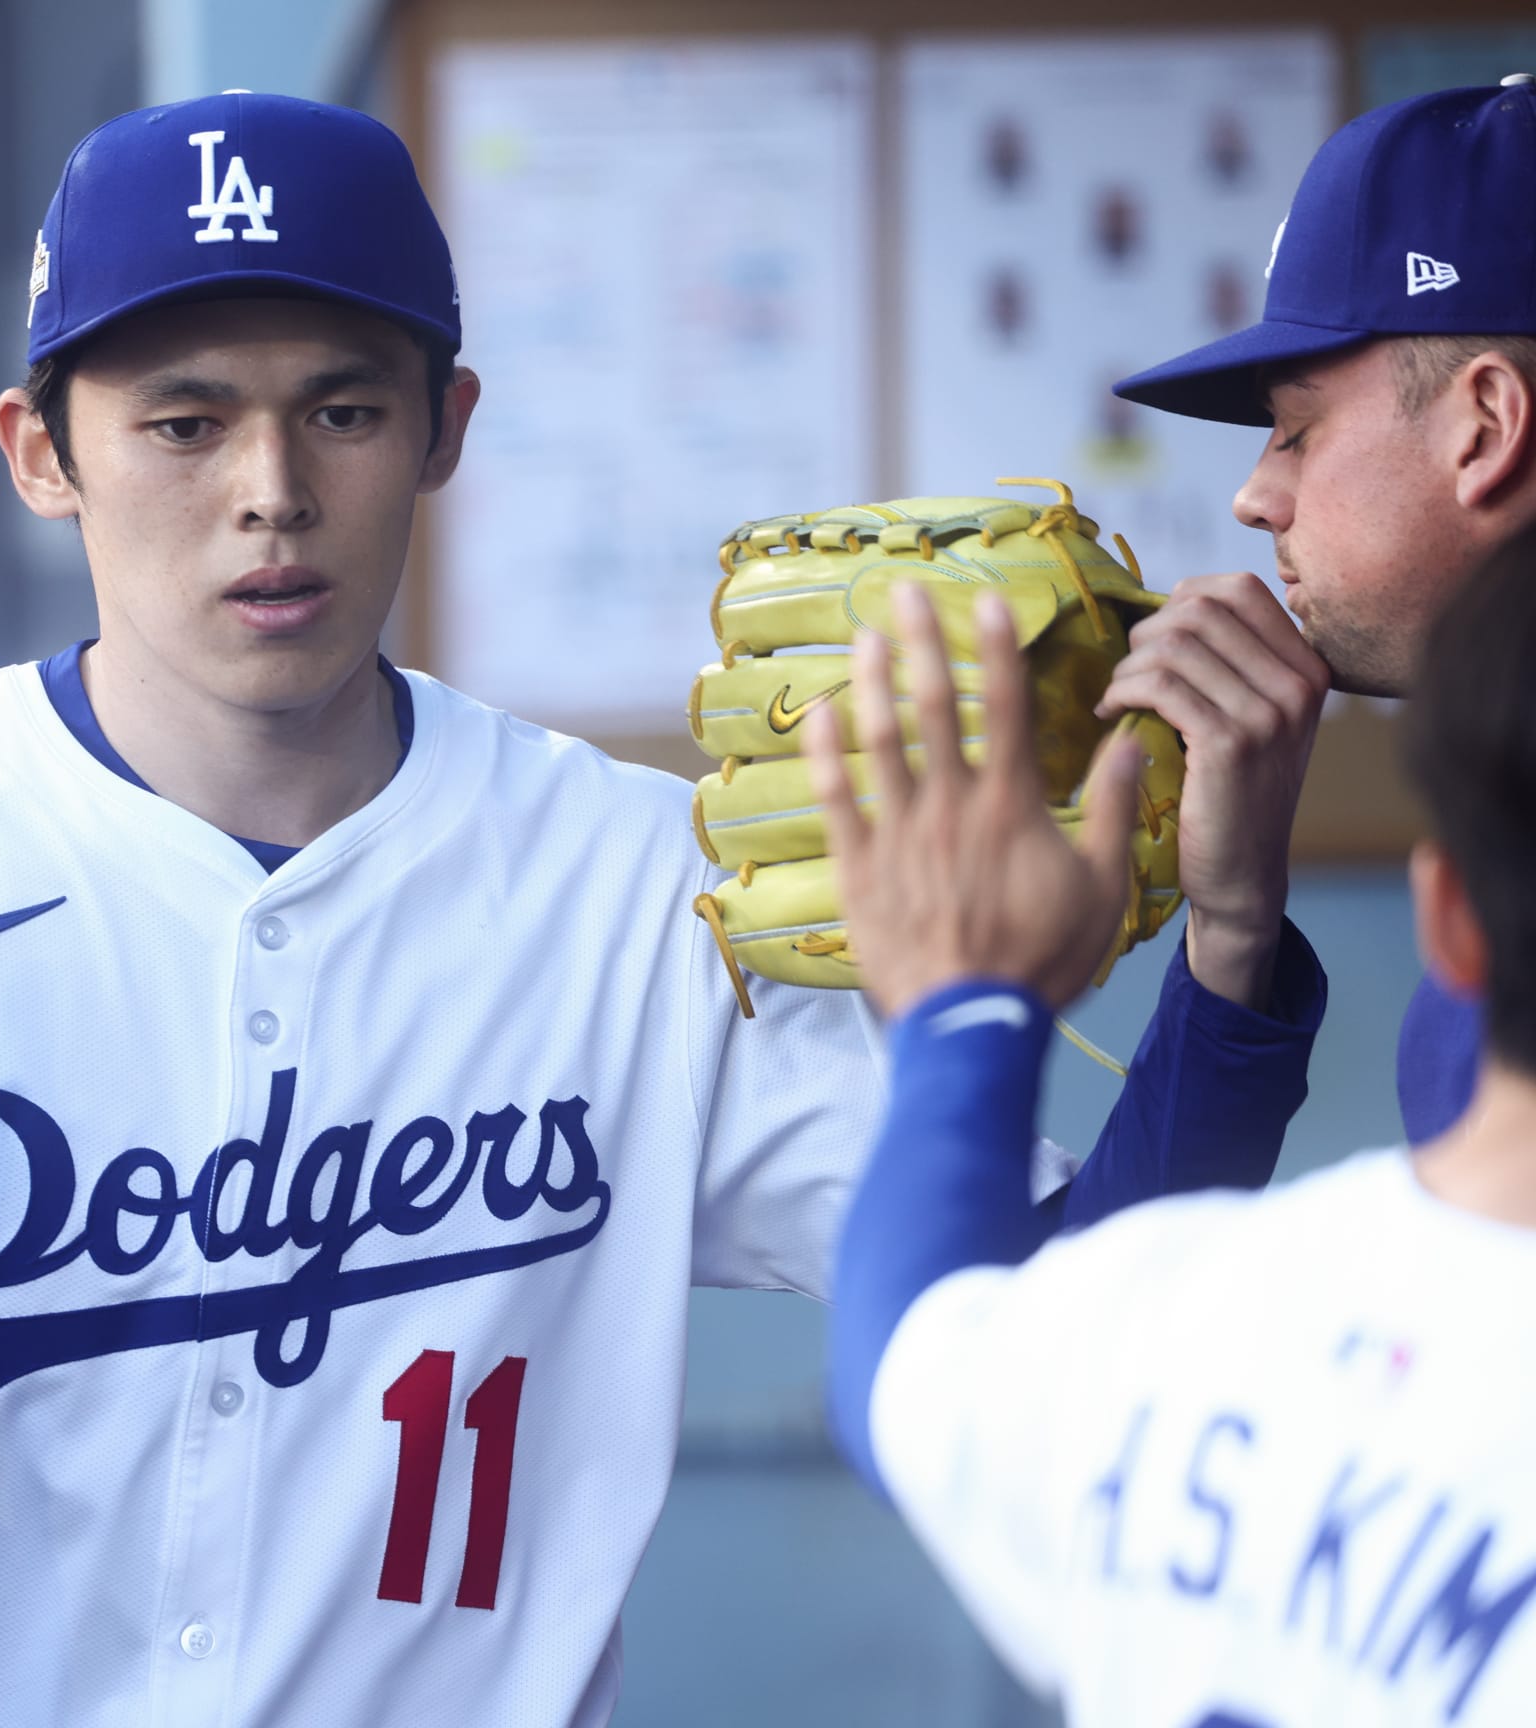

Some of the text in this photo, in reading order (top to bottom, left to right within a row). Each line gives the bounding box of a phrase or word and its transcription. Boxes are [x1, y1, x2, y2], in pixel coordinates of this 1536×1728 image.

[187, 130, 279, 244] LA
[376, 1348, 528, 1611] 11
[1278, 1452, 1536, 1728] KIM
